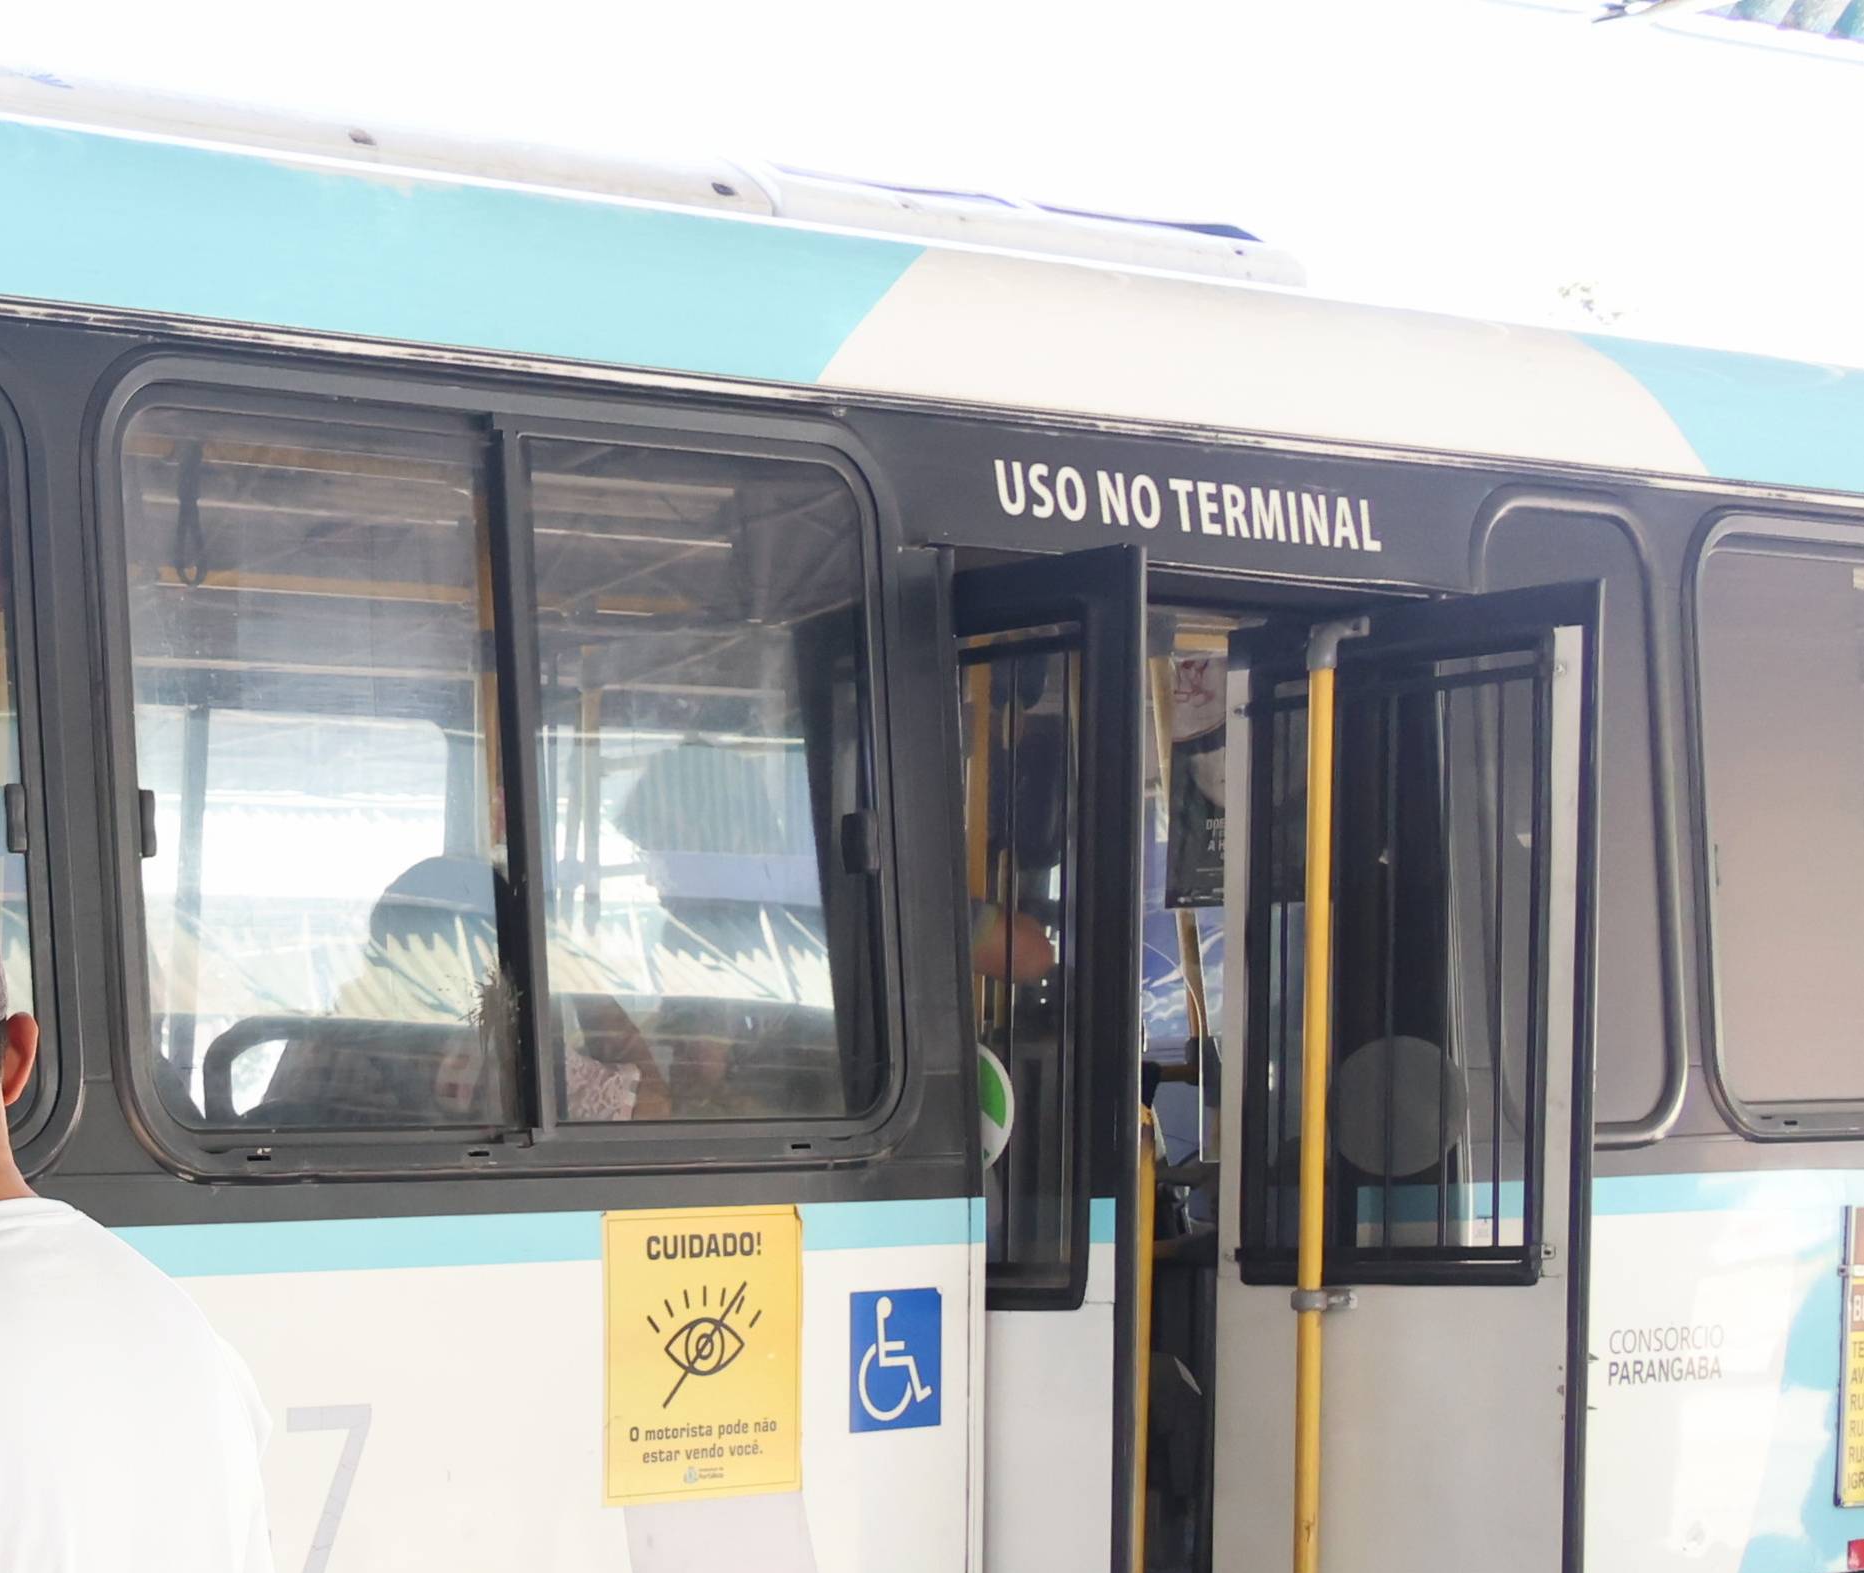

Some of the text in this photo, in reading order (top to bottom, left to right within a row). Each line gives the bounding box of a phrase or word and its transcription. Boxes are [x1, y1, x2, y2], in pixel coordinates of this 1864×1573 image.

[993, 458, 1383, 552] USO NO TERMINAL
[646, 1231, 762, 1261] CUIDADO!
[1607, 1355, 1723, 1386] PARANGABA
[629, 1416, 777, 1442] O motorista pode não
[642, 1439, 764, 1464] estar vendo você.
